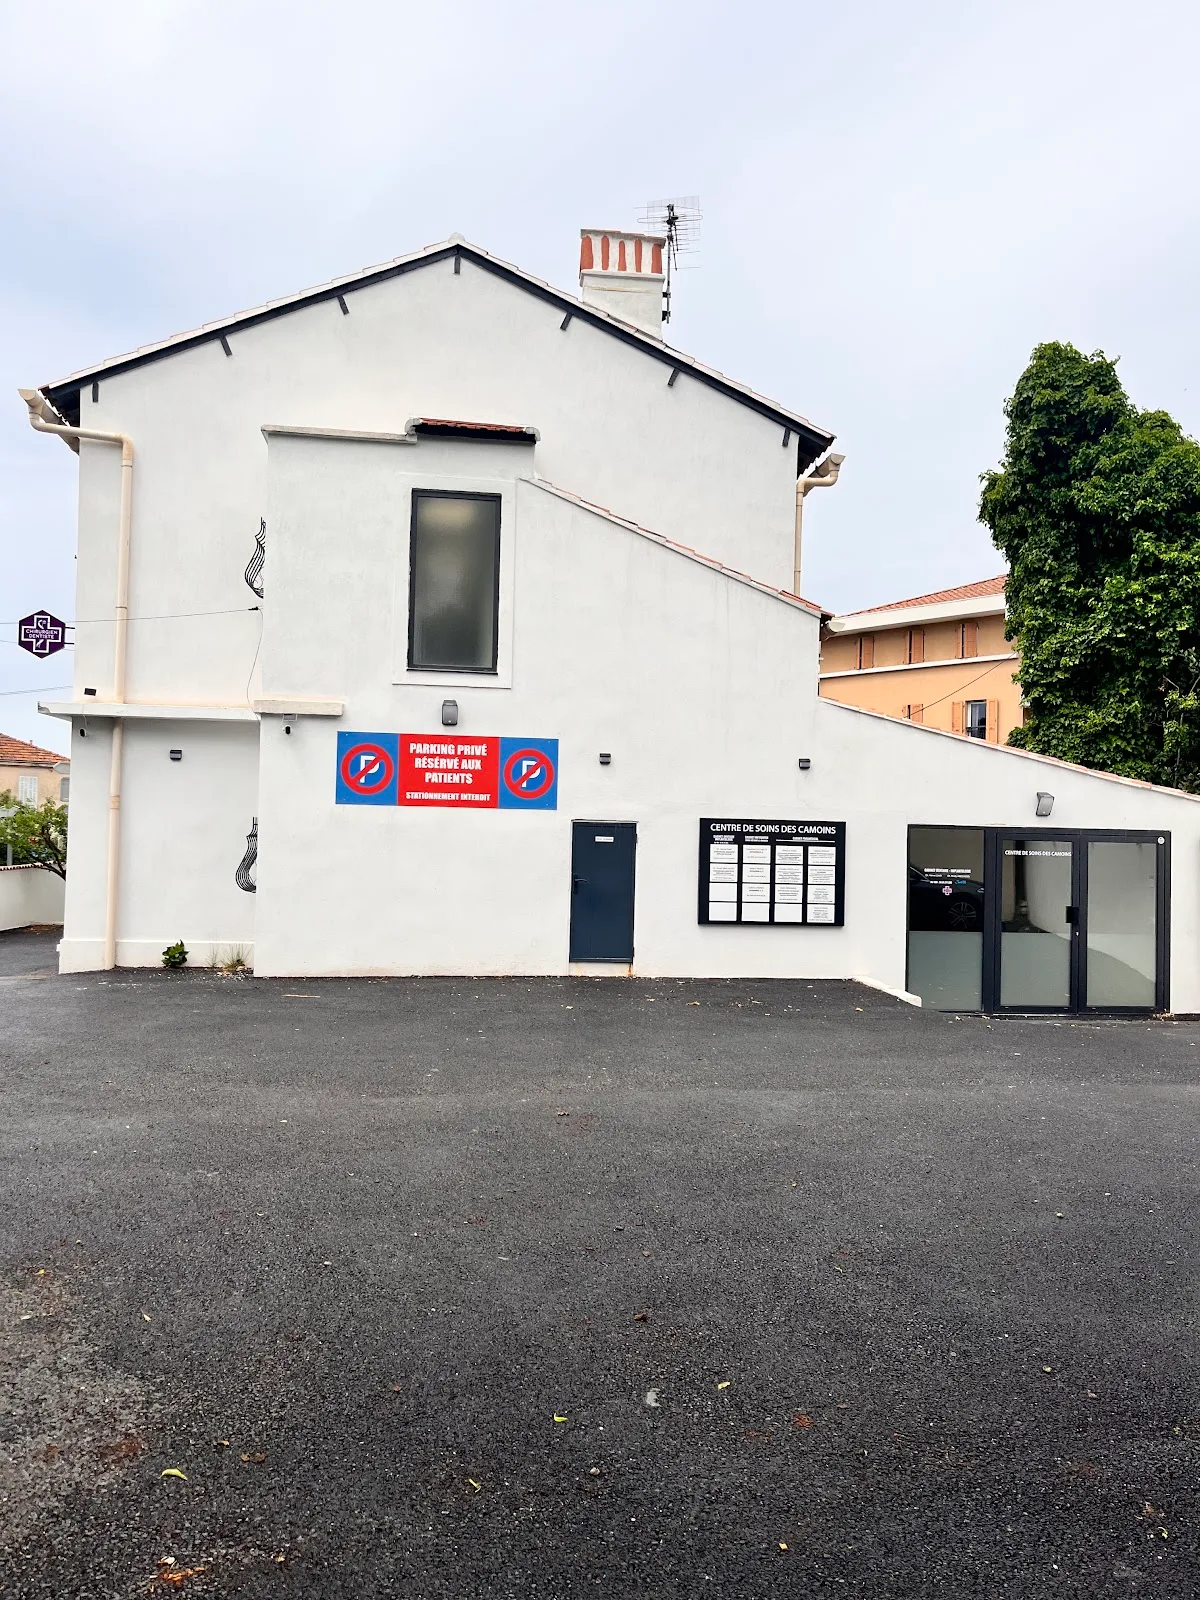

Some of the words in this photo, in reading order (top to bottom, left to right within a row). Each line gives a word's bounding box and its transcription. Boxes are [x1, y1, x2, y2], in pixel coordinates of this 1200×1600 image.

[409, 742, 455, 755] PARKING
[456, 743, 487, 756] PRIVÉ
[414, 756, 459, 770] RÉSÉRVÉ
[460, 758, 482, 770] AUX
[424, 771, 473, 785] PATIENTS
[405, 791, 460, 801] STATIONNEMENT
[460, 793, 491, 802] INTERDIT
[710, 823, 742, 832] CENTRE
[742, 824, 755, 833] DE
[754, 824, 780, 833] SOINS
[780, 825, 797, 834] DES
[797, 825, 837, 835] CAMOINS
